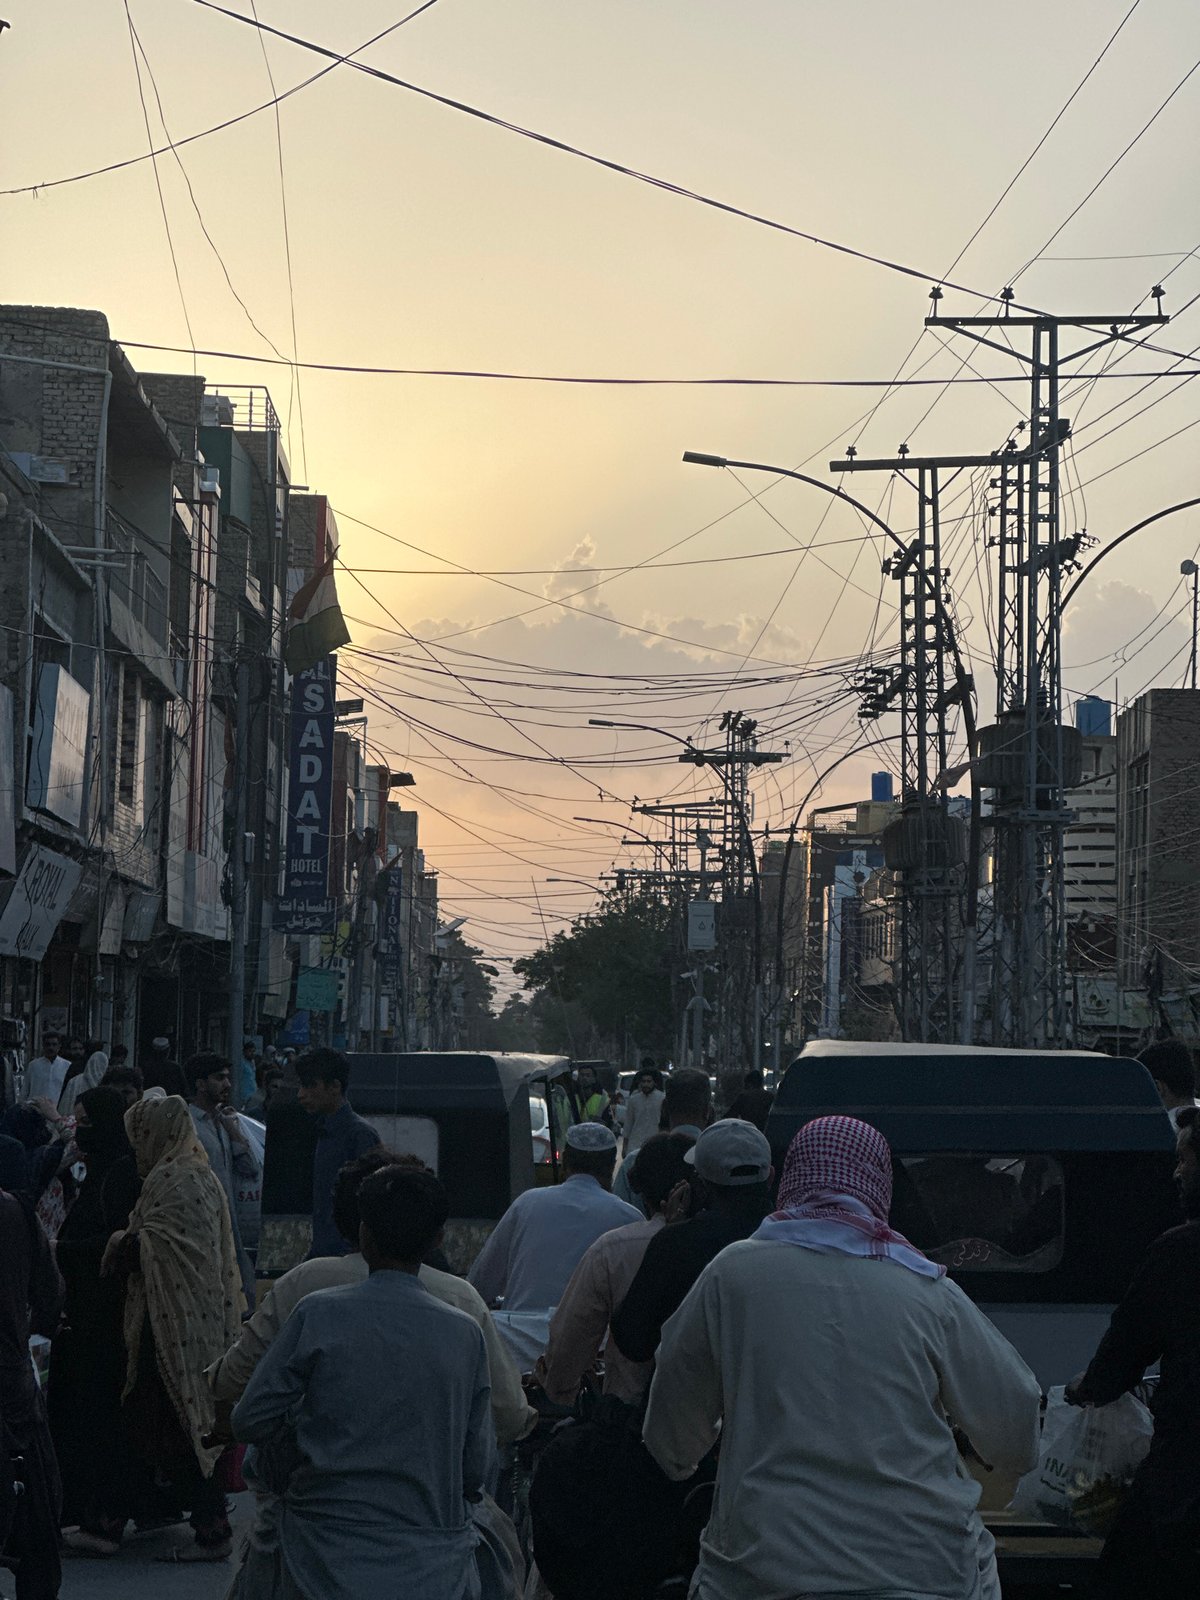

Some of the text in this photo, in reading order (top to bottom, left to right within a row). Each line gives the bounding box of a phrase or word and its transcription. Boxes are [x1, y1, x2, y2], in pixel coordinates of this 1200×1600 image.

[296, 684, 325, 855] SADAT
[291, 858, 323, 873] HOTEL
[25, 860, 67, 910] ROYAL
[279, 898, 333, 912] السادات
